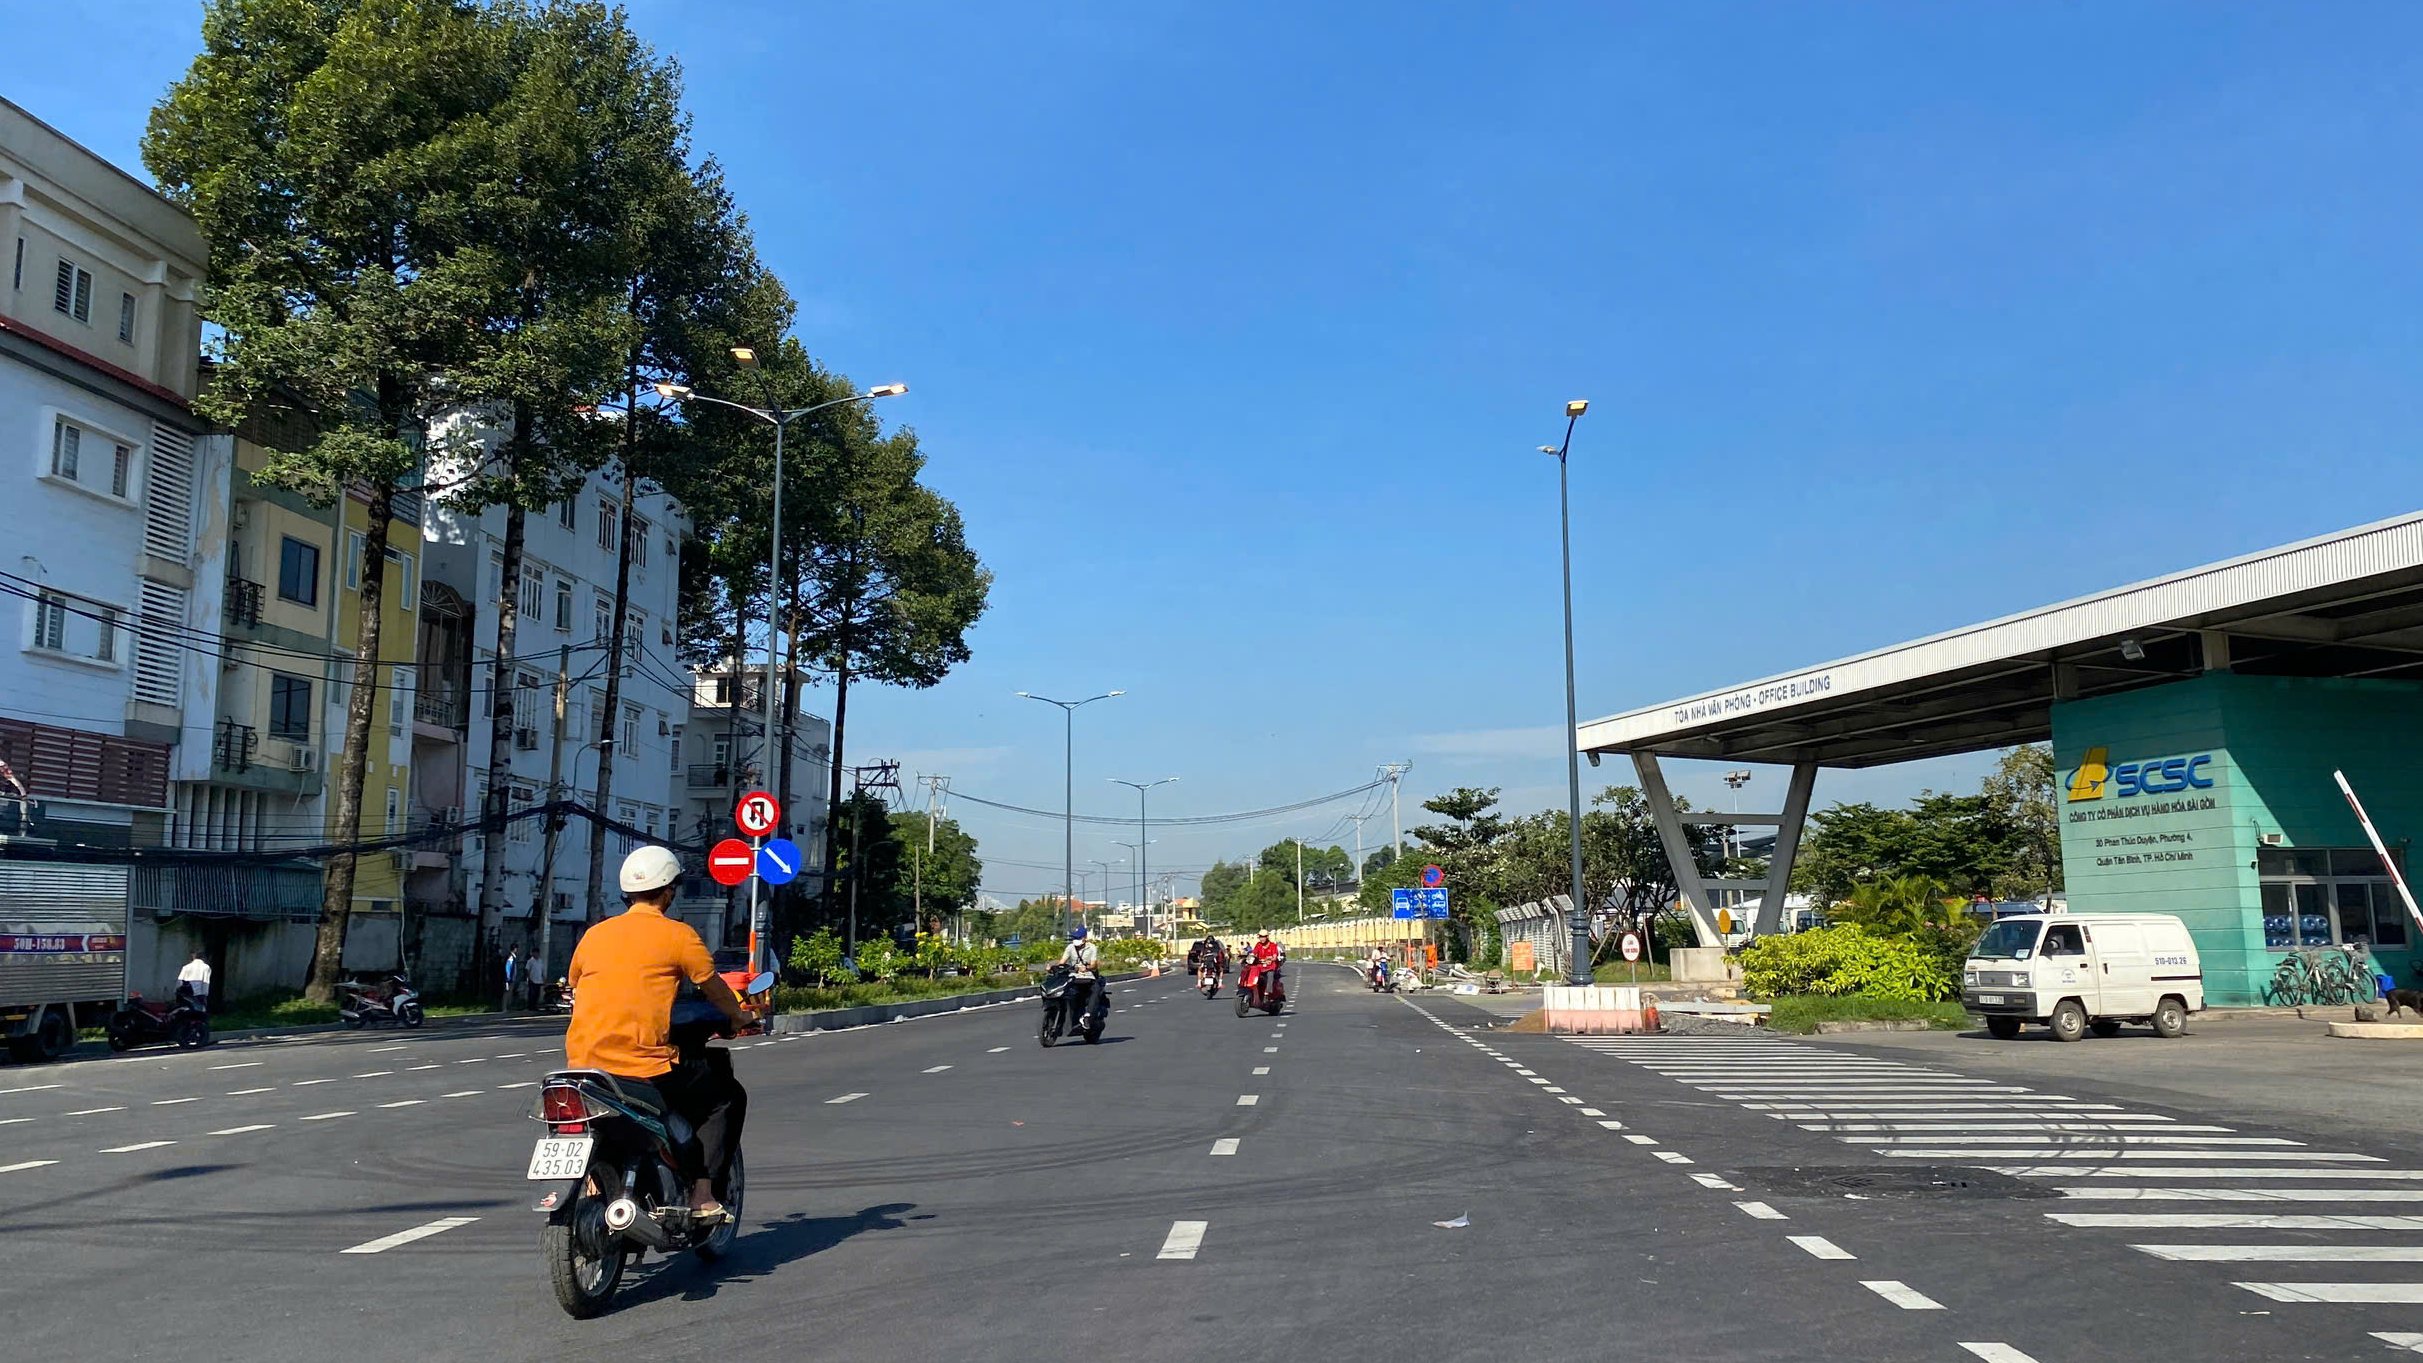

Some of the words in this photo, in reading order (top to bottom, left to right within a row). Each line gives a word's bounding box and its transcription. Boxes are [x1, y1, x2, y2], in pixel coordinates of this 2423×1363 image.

[1674, 706, 1689, 725] TÒA
[1691, 704, 1707, 719] NHÀ
[1708, 701, 1722, 717] VĂN
[1724, 693, 1751, 712] PHÒNG
[1758, 685, 1788, 705] OFFICE
[1790, 675, 1831, 698] BUILDING
[2116, 754, 2214, 797] SCSC
[2069, 810, 2087, 823] CÔNG
[2087, 811, 2097, 821] TY
[2125, 805, 2140, 819] DỊCH
[2140, 804, 2151, 818] VỤ
[2151, 801, 2170, 815] HÀNG
[2171, 799, 2186, 813] HÓA
[2187, 798, 2199, 811] SÀI
[2200, 796, 2216, 810] GÒN
[2104, 838, 2120, 847] Phan
[2113, 856, 2126, 865] Tân
[2177, 852, 2193, 861] Minh
[542, 1141, 584, 1158] 59-D2
[532, 1159, 584, 1176] 435.03
